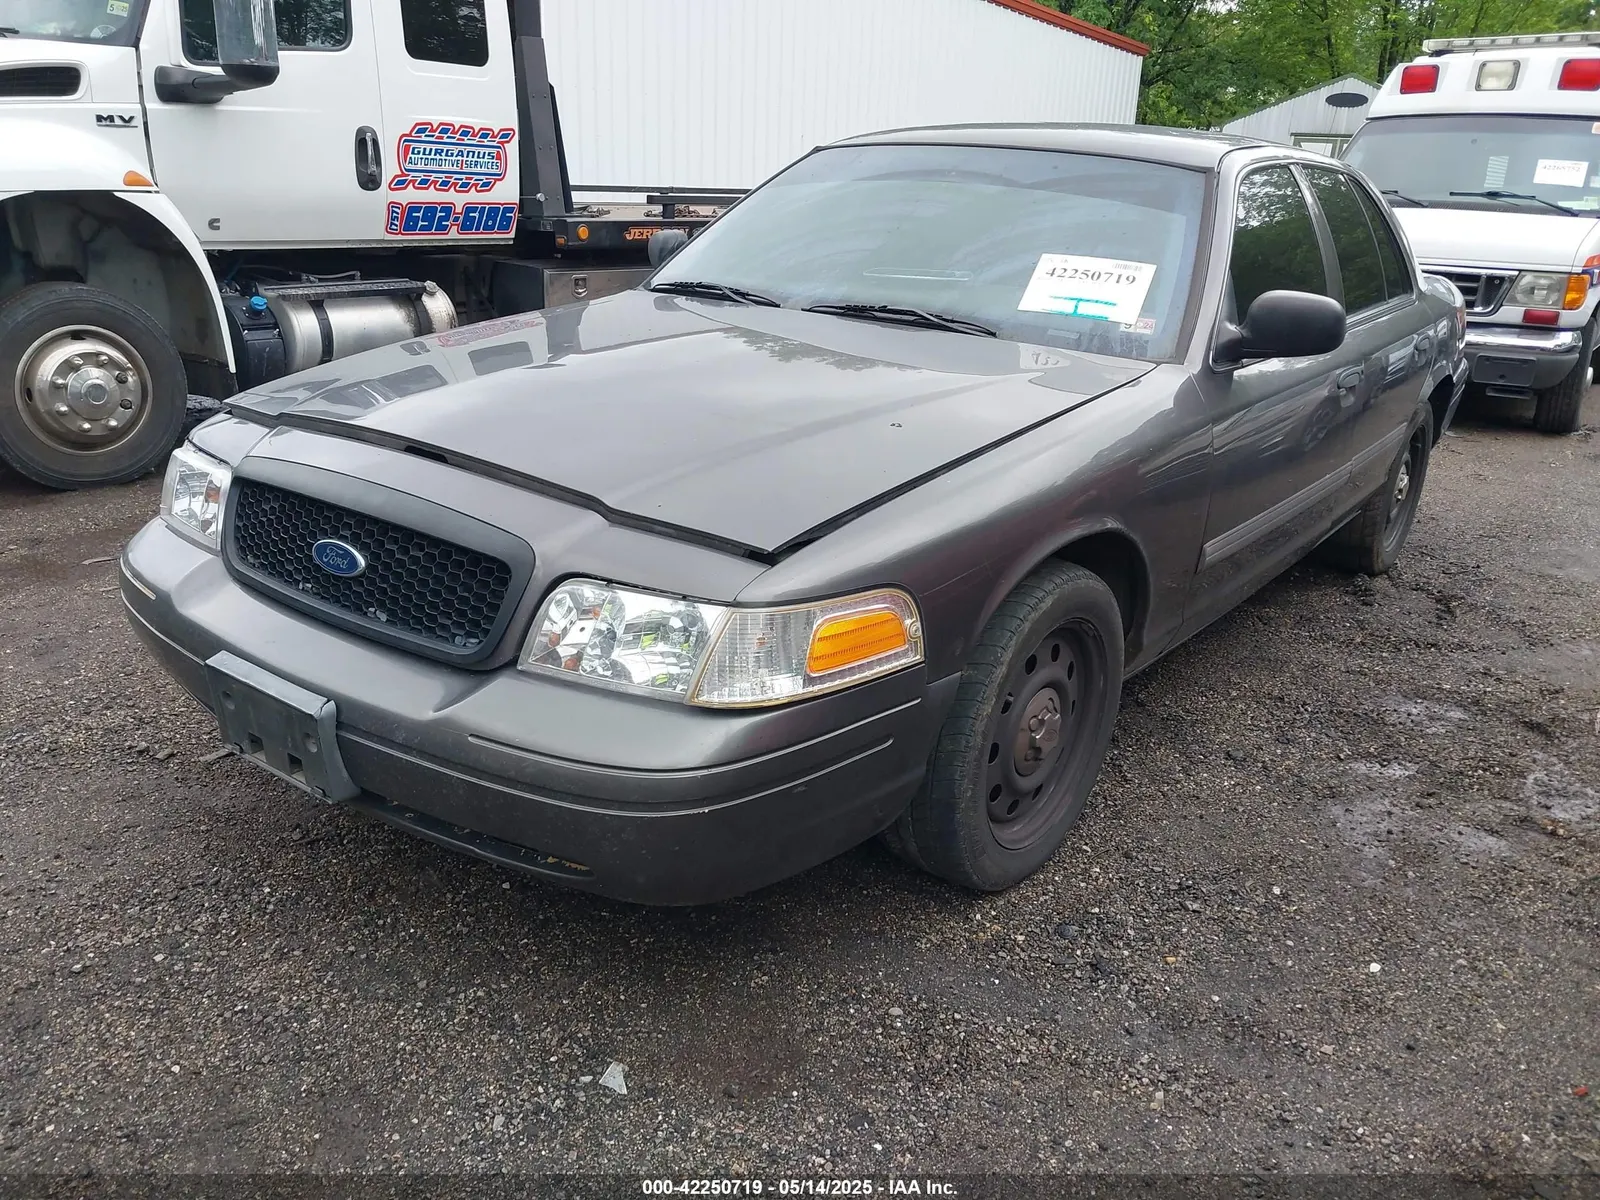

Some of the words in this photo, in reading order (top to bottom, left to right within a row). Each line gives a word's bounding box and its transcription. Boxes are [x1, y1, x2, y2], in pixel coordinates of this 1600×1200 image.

[95, 114, 135, 124] MV
[410, 146, 496, 160] GURGANUS
[407, 156, 460, 168] AUTOMOTIVE
[464, 160, 500, 171] SERVICES
[402, 205, 516, 232] 692-6186
[1045, 267, 1137, 285] 42250719
[322, 545, 351, 569] Ford
